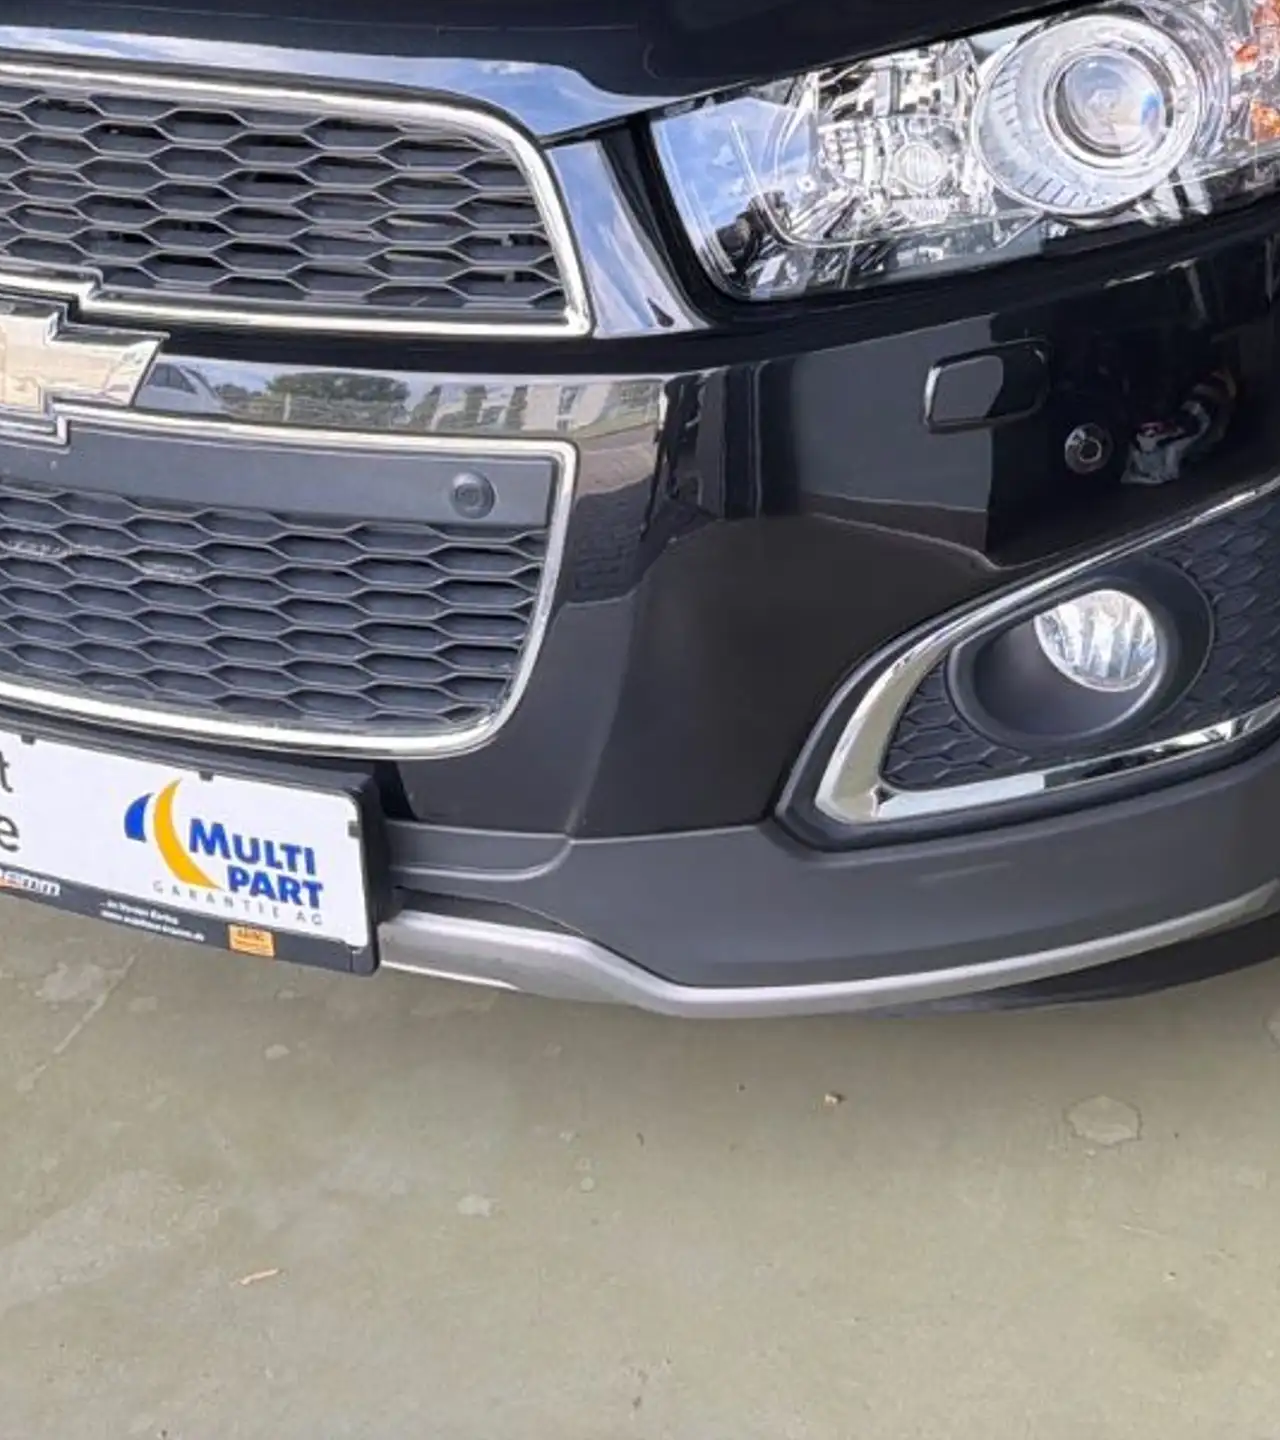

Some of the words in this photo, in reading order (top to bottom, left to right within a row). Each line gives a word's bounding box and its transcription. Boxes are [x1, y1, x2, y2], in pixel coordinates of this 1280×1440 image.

[188, 817, 317, 876] MULTI
[152, 879, 280, 919] GARANTIE
[296, 910, 324, 926] AG
[227, 863, 324, 910] PART
